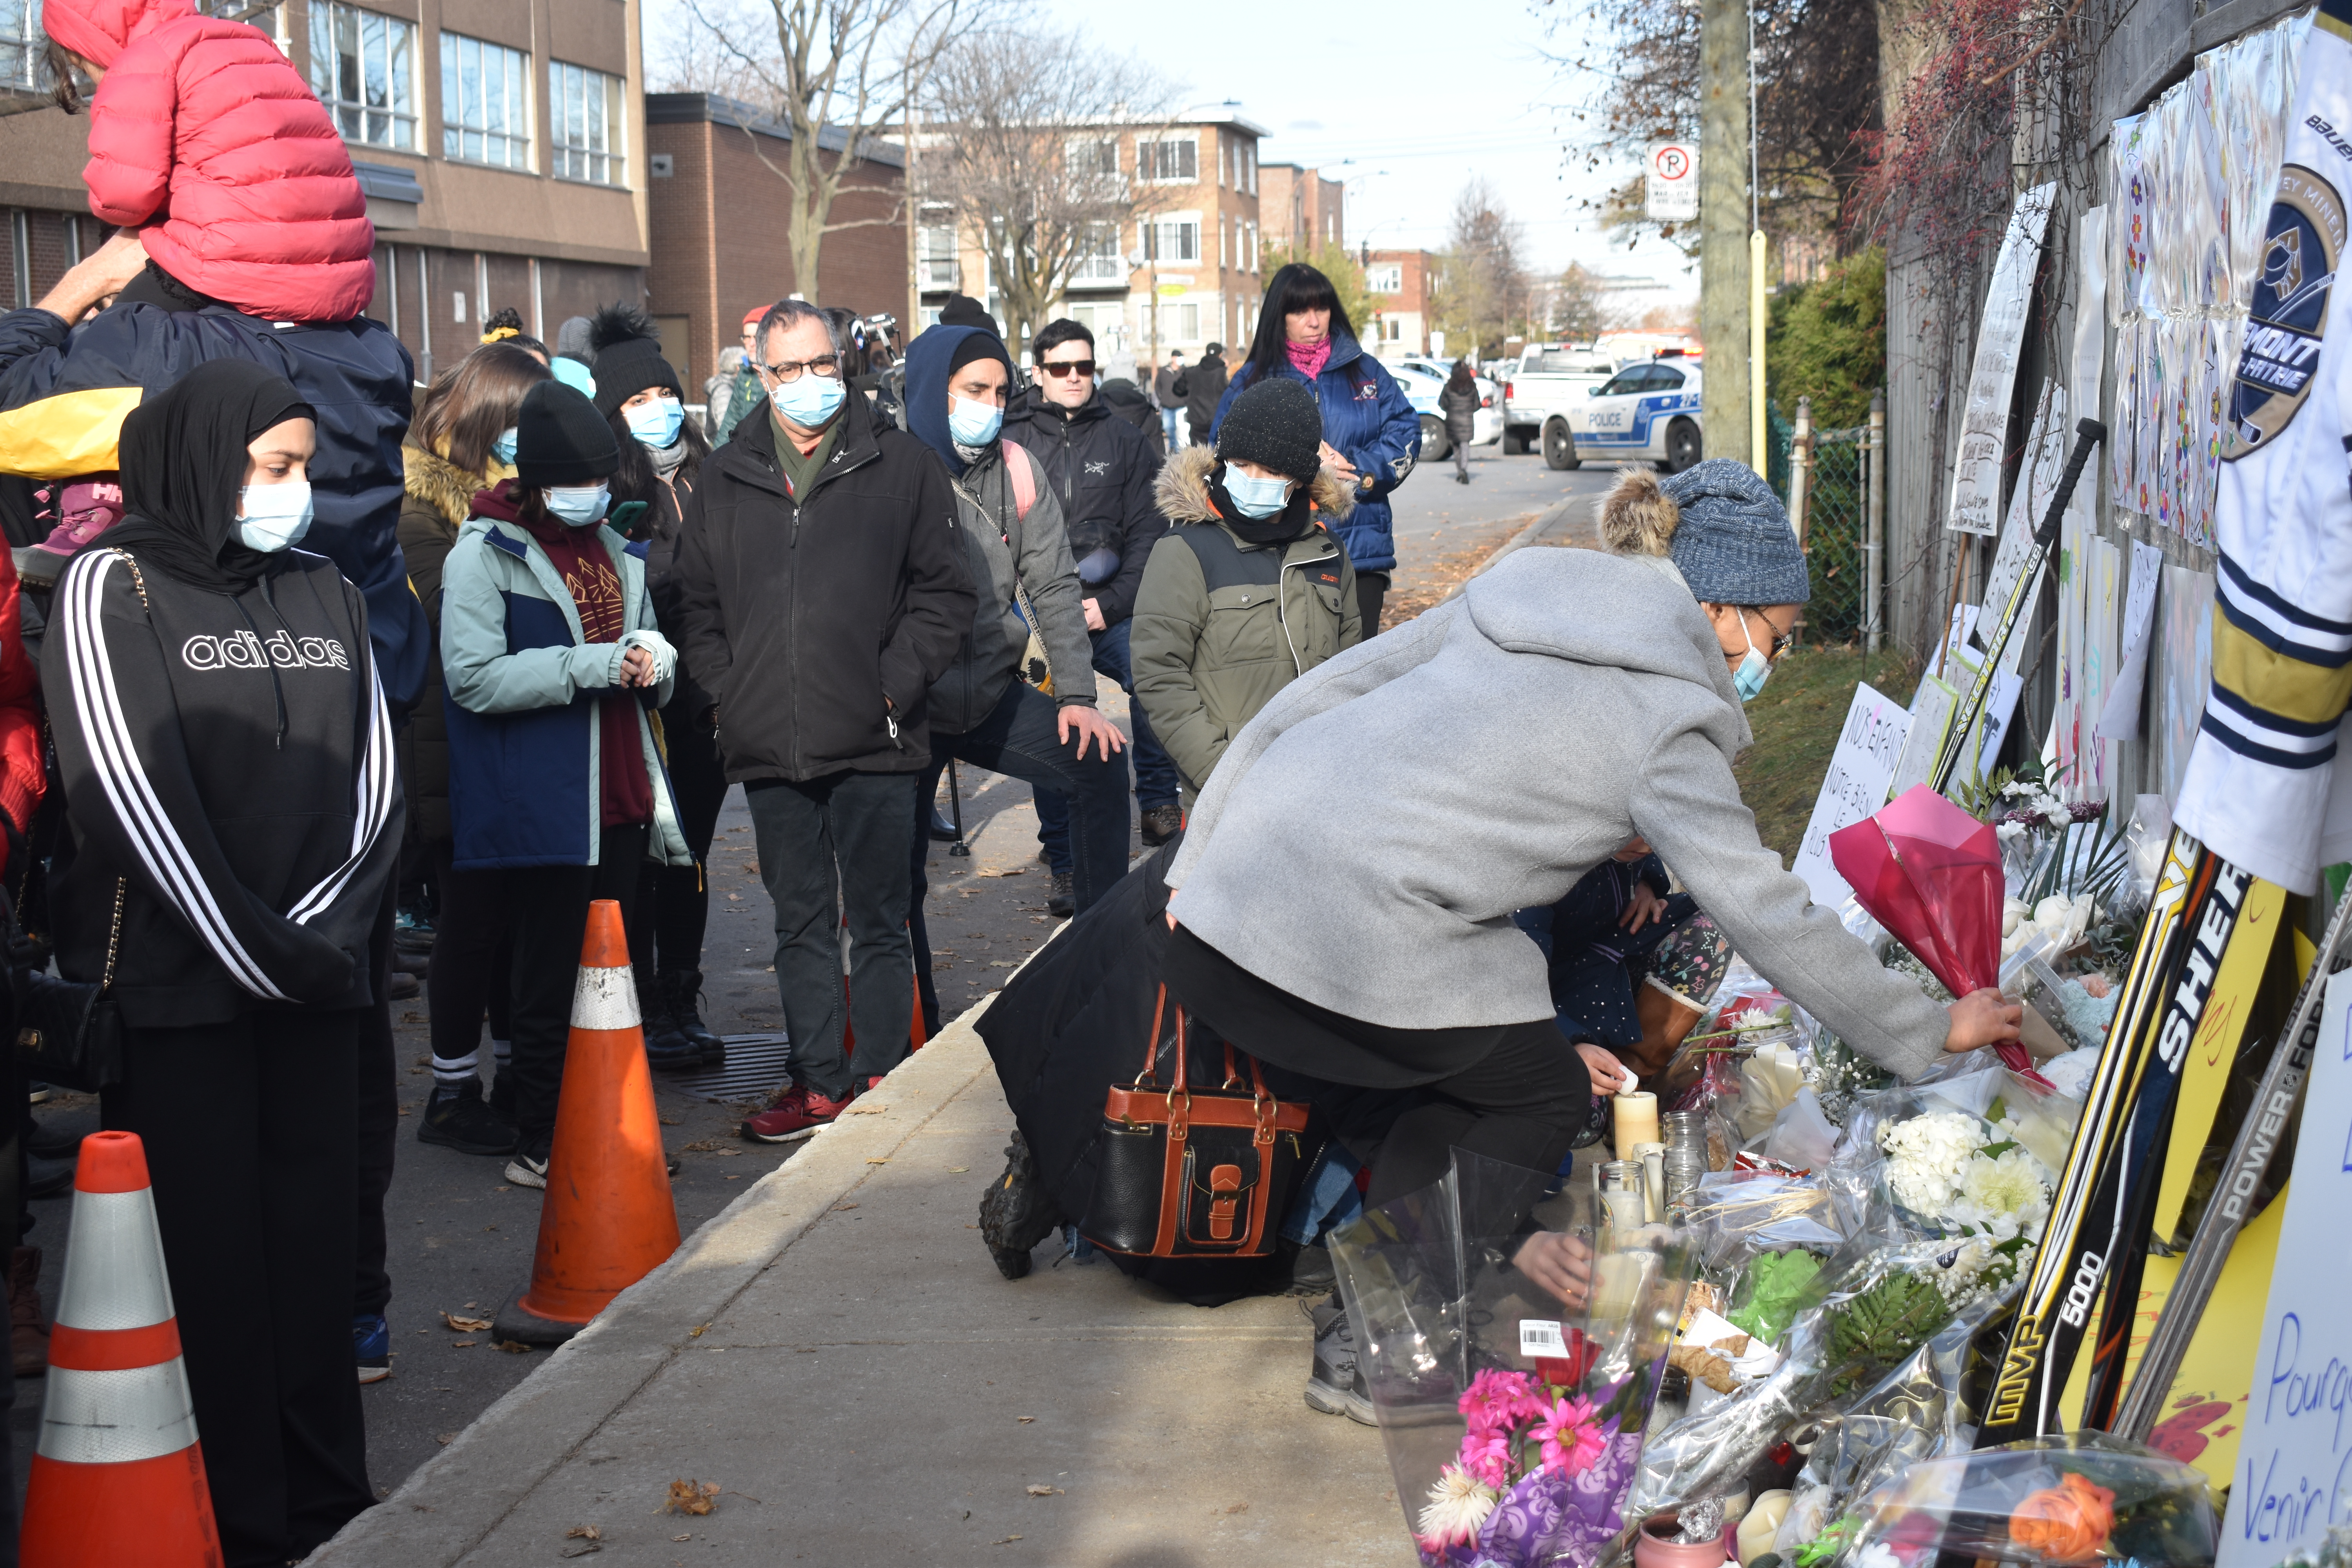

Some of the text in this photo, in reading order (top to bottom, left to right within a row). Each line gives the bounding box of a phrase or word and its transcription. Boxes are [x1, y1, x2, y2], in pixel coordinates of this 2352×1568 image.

[1668, 155, 1679, 172] P
[1589, 413, 1621, 426] POLICE
[183, 630, 350, 670] adidas
[1955, 623, 2009, 732] VECTOR
[1845, 704, 1873, 749] NOS
[1867, 714, 1908, 773] ENFANTS
[1824, 763, 1852, 801] NOTRE
[1805, 826, 1826, 858] PLUS
[1833, 805, 1846, 829] LE
[2221, 1090, 2292, 1222] POWER
[2061, 1250, 2104, 1328] 5000
[1985, 1315, 2045, 1426] MVP
[2245, 1448, 2322, 1542] Venir
